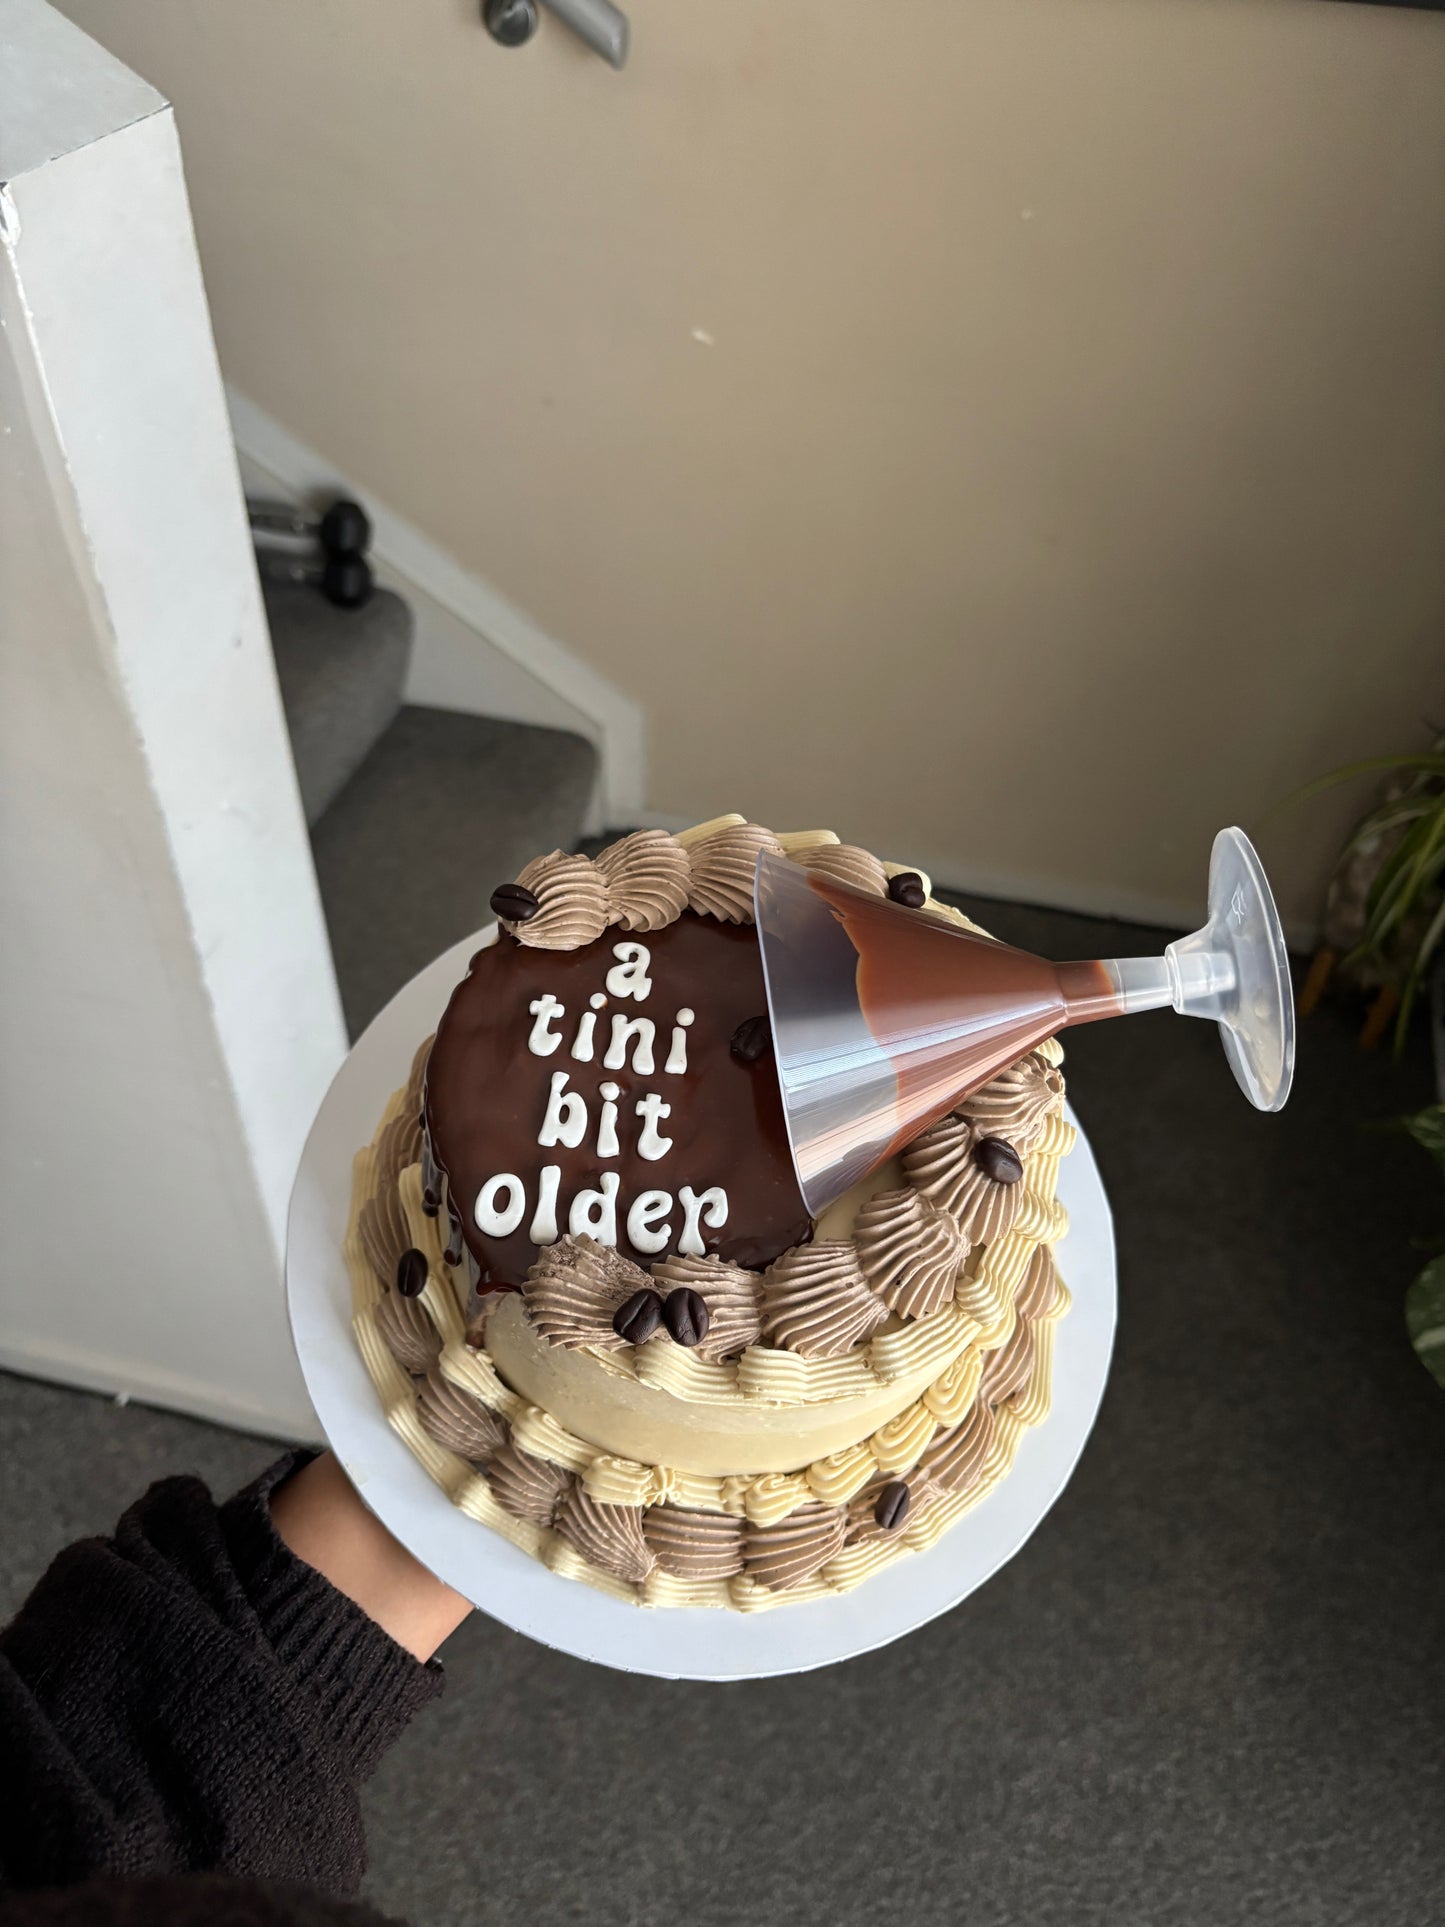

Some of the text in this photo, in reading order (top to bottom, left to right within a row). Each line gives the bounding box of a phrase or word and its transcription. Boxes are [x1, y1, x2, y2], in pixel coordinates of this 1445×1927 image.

[605, 942, 653, 1002] a
[528, 993, 695, 1076] tini
[538, 1071, 673, 1161] bit
[474, 1164, 729, 1255] older
